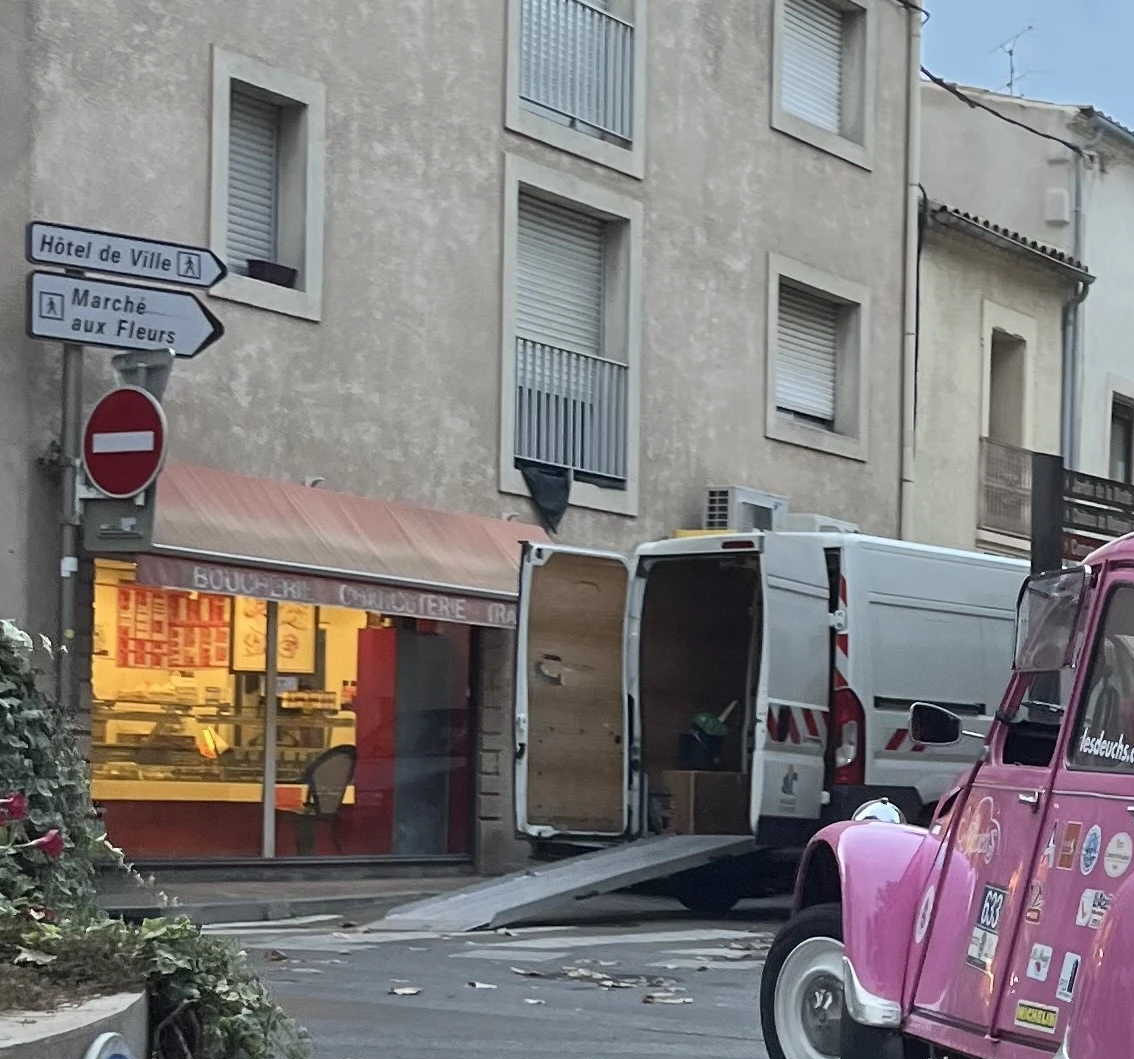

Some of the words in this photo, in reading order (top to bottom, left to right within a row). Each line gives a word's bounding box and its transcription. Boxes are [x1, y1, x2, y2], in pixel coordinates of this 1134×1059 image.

[40, 234, 92, 259] Hôtel
[100, 245, 120, 263] de
[131, 249, 171, 271] Ville
[72, 288, 146, 315] Marché
[71, 317, 106, 334] aux
[117, 319, 177, 344] Fleurs
[980, 889, 1004, 929] 633
